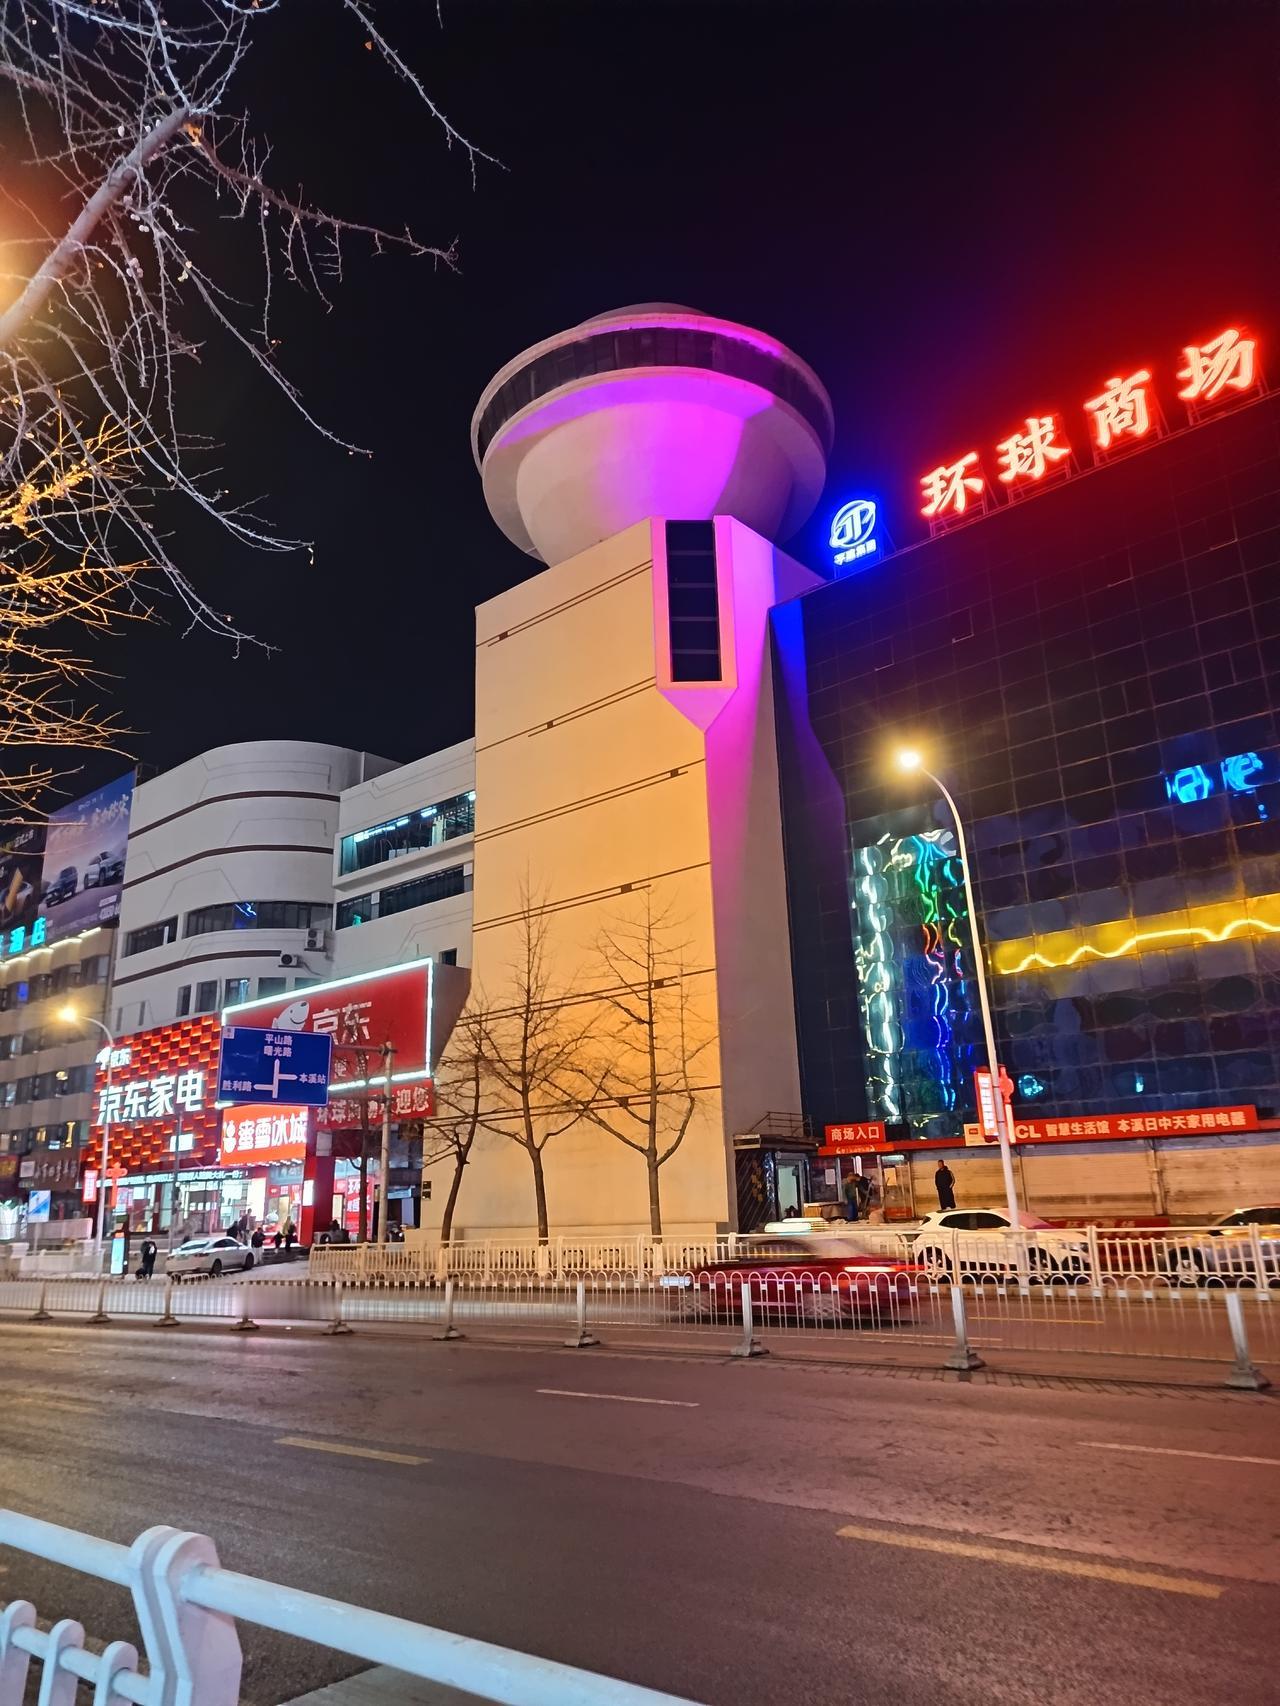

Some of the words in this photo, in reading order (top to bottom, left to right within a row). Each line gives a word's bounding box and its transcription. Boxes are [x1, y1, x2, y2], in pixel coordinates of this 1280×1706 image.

[920, 329, 1255, 516] 环球商场
[312, 1001, 372, 1046] 京东
[264, 1033, 293, 1045] 平山路
[110, 1048, 131, 1068] 京东
[263, 1045, 293, 1057] 曙光路
[222, 1080, 252, 1092] 胜利路
[298, 1073, 326, 1085] 本溪站
[97, 1070, 205, 1124] 京东家电
[237, 1111, 309, 1152] 蜜雪冰城
[832, 1126, 880, 1141] 商场入口
[1014, 1124, 1042, 1140] CL
[1045, 1120, 1110, 1137] 智慧生活馆
[1118, 1111, 1246, 1133] 本溪日中天家用电器
